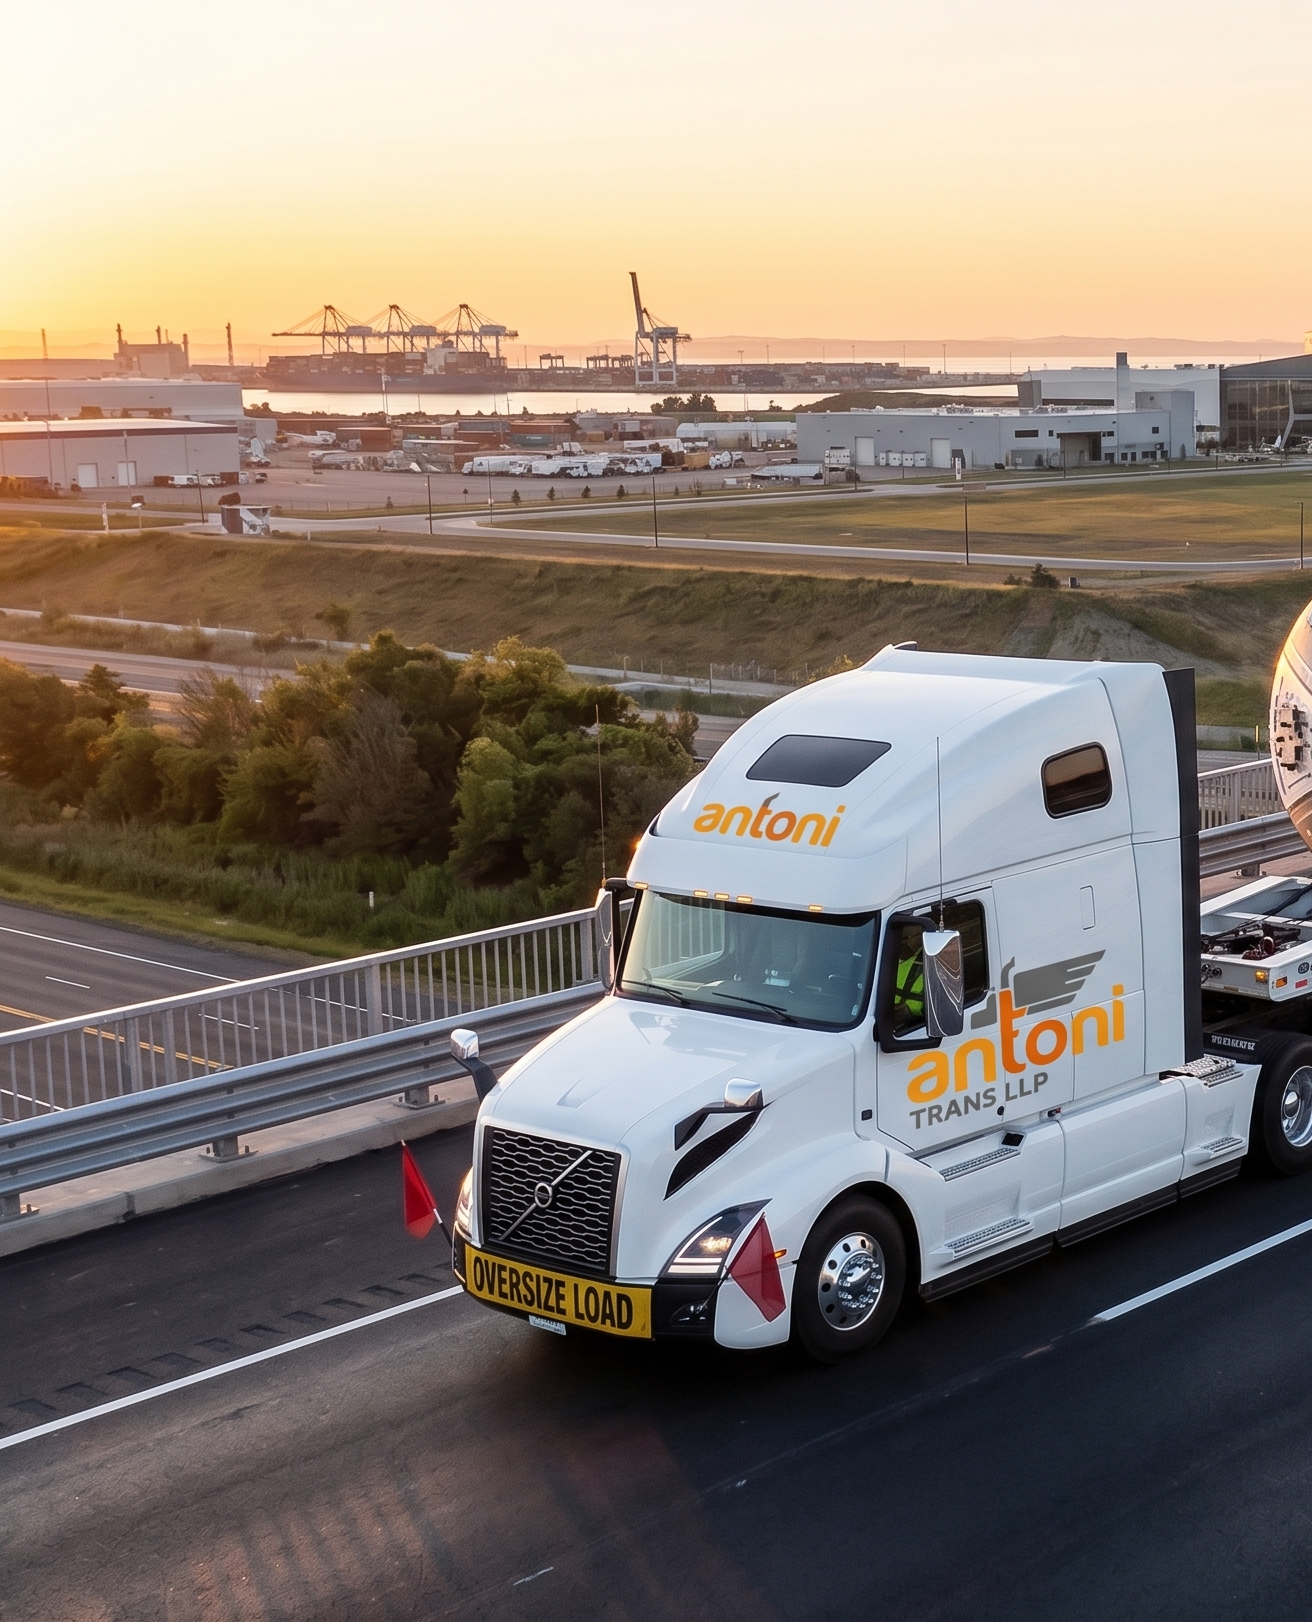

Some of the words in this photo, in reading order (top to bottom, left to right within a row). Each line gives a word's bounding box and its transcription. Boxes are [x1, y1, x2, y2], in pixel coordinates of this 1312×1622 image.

[693, 793, 846, 847] antoni
[907, 984, 1124, 1104] antoni
[909, 1087, 996, 1130] TRANS
[1005, 1072, 1049, 1102] LLP
[474, 1256, 567, 1316] OVERSIZE
[574, 1283, 633, 1330] LOAD
